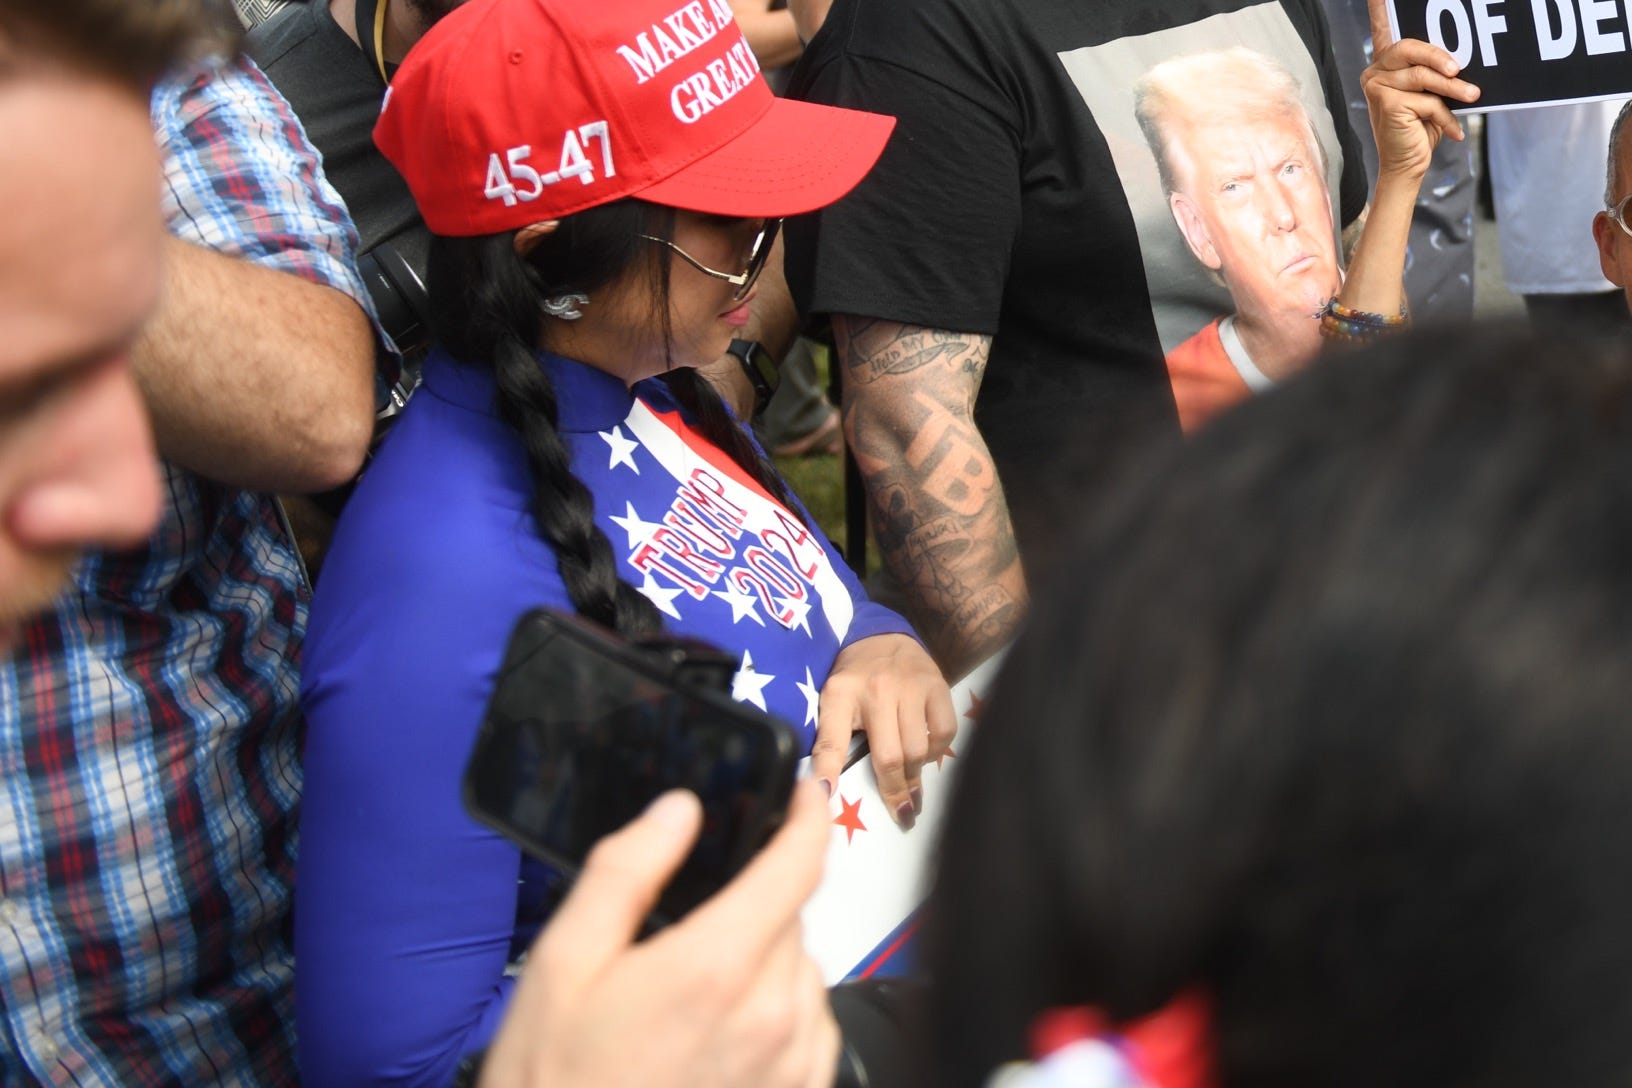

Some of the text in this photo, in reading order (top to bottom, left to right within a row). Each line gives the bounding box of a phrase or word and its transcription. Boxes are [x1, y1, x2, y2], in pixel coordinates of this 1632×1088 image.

[615, 0, 718, 85] MAKE
[670, 42, 756, 125] GREAT
[484, 120, 616, 208] 45-47
[628, 466, 749, 602] TRUMP
[731, 509, 827, 629] 2024
